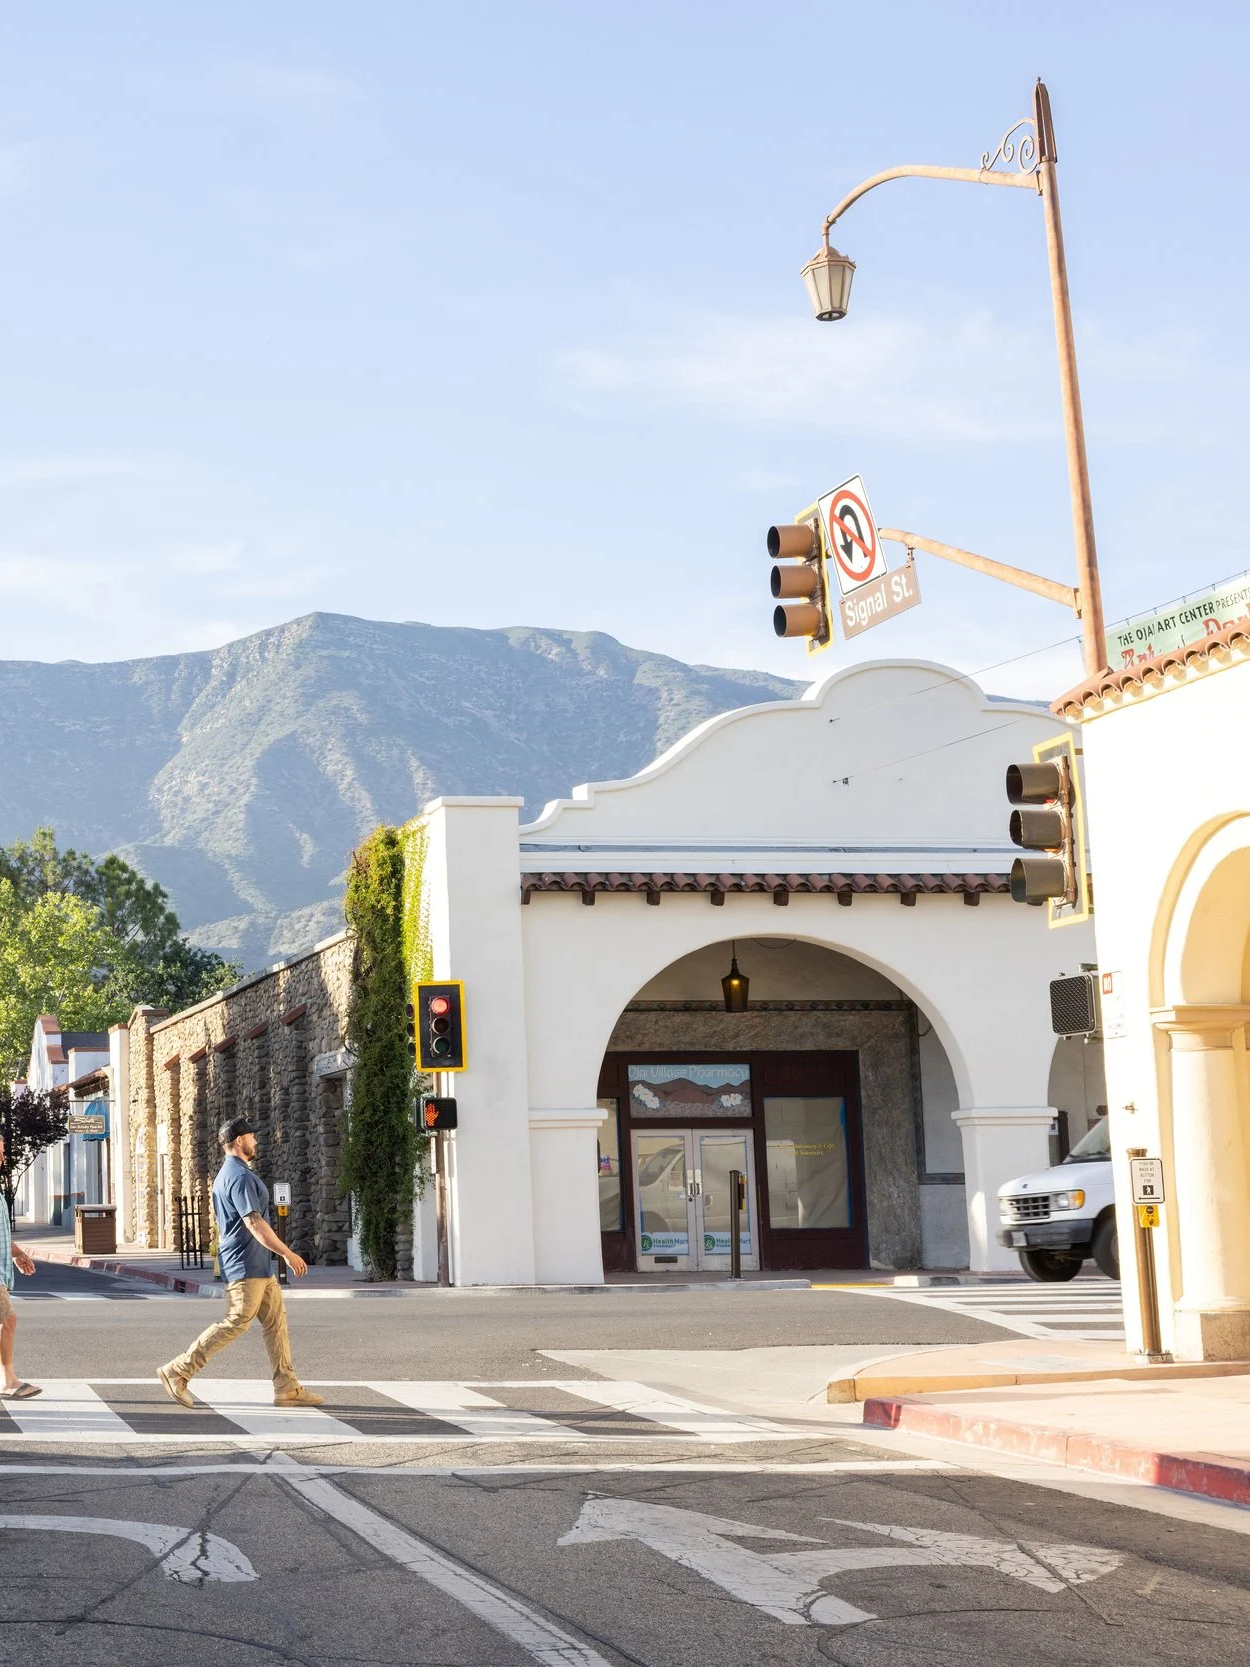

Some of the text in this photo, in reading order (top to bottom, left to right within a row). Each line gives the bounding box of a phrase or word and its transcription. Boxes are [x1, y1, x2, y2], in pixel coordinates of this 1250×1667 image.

[845, 573, 913, 627] Signal St.
[1117, 631, 1135, 647] THE
[1136, 623, 1156, 641] OJAI
[1157, 616, 1177, 634] ART
[1179, 601, 1215, 624] CENTER
[689, 1065, 749, 1079] Pharmacy
